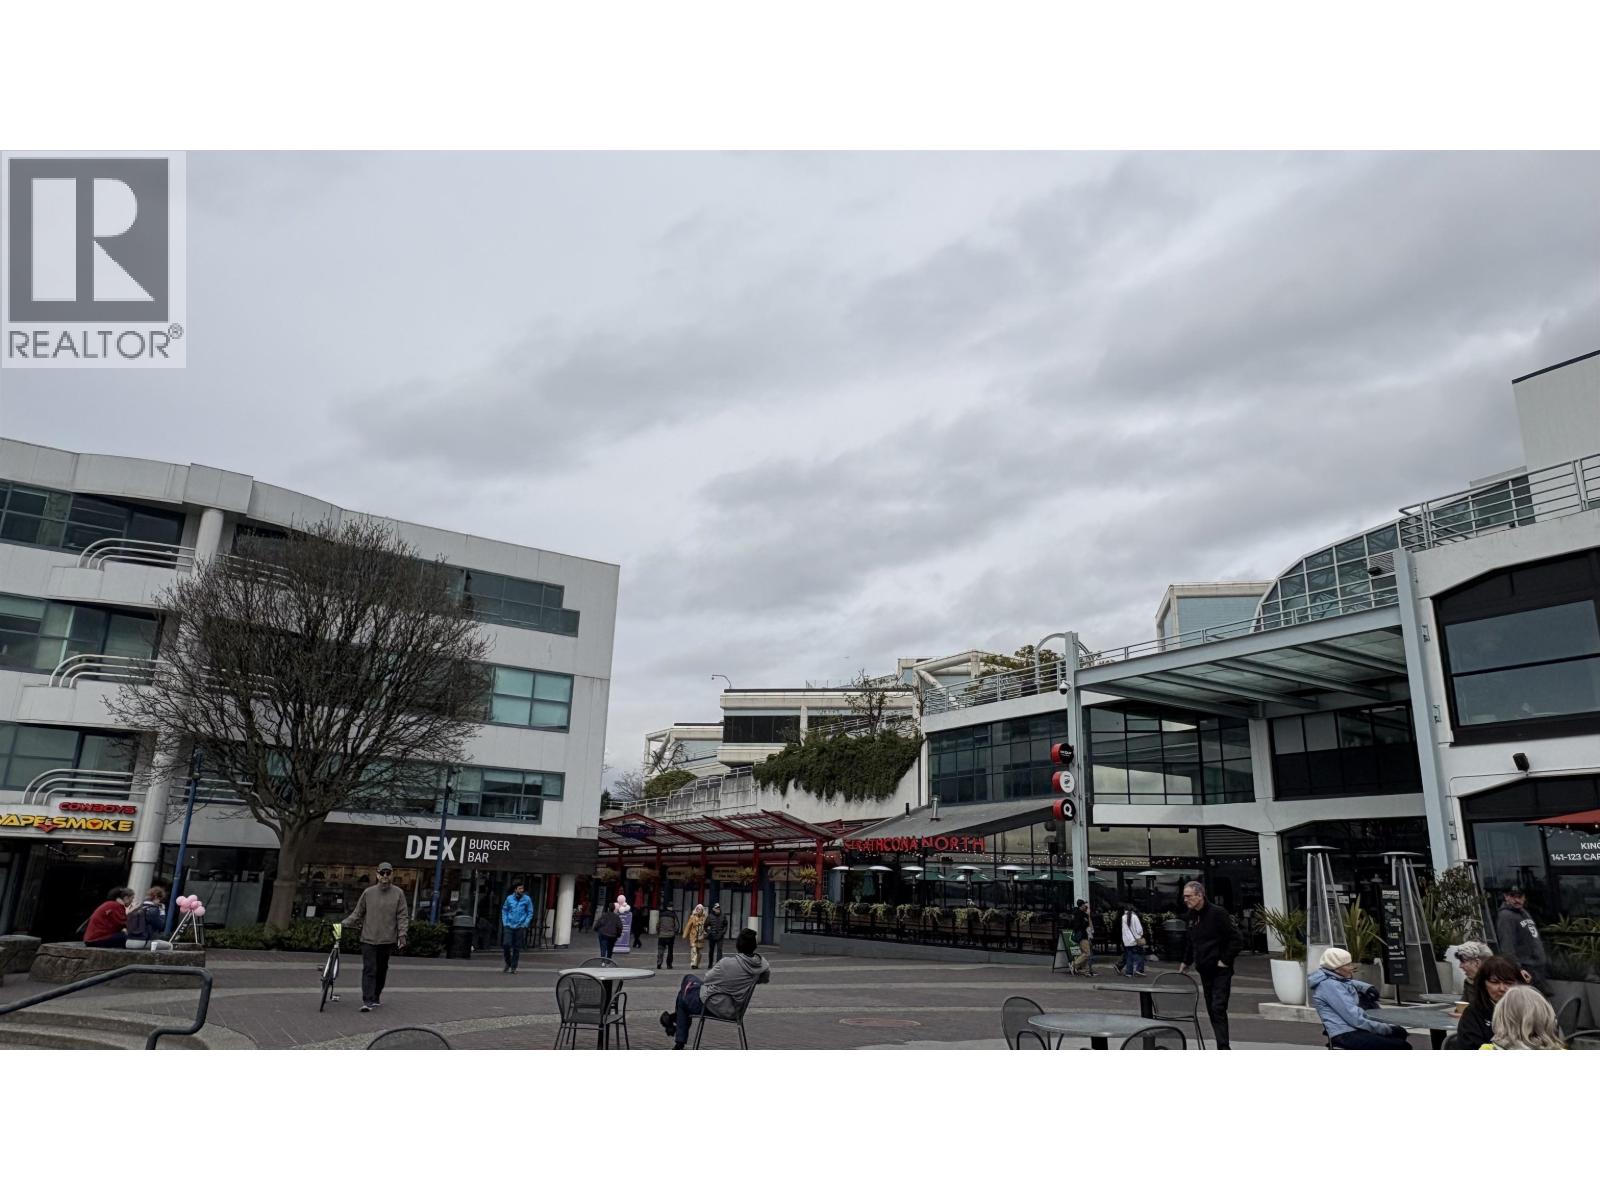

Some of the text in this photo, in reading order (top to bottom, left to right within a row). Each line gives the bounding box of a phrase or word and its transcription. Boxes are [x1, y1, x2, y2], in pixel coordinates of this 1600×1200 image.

[59, 802, 137, 814] COWBOYS
[1063, 803, 1073, 816] Q
[405, 835, 458, 861] DEX
[469, 839, 510, 851] BURGER
[922, 835, 985, 851] NORTH
[467, 851, 489, 863] BAR
[1551, 853, 1582, 861] 141-123
